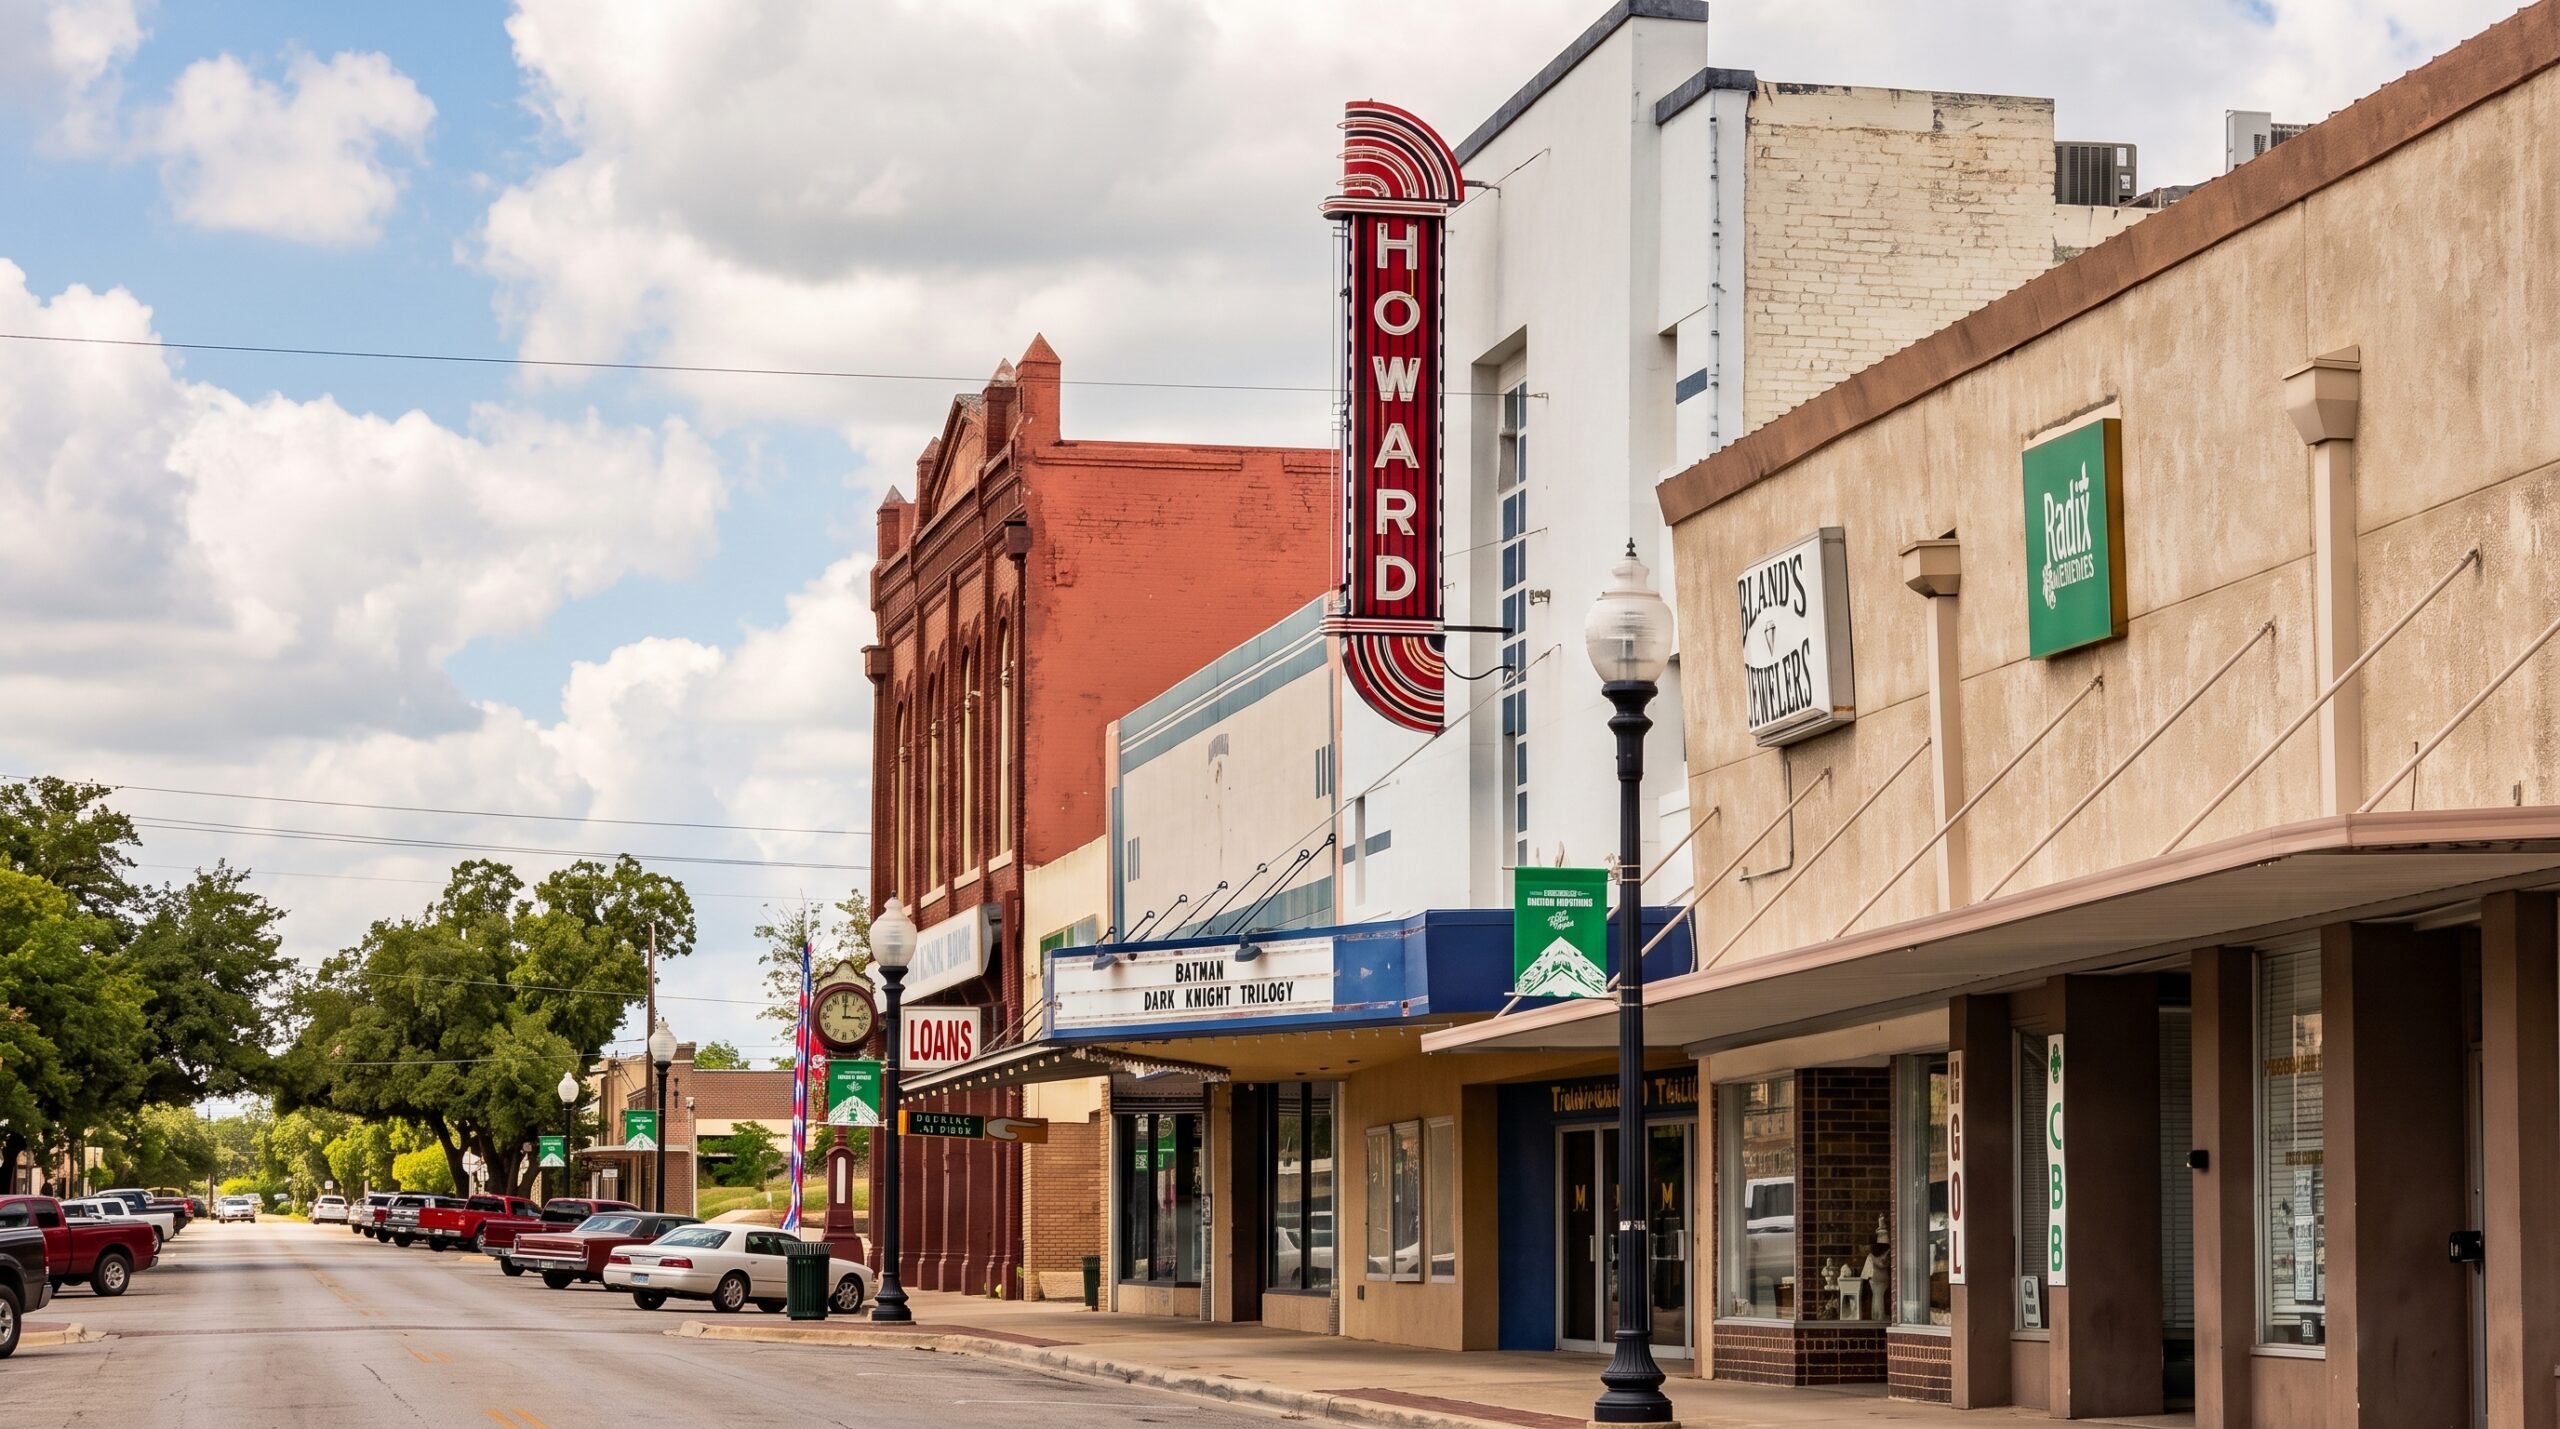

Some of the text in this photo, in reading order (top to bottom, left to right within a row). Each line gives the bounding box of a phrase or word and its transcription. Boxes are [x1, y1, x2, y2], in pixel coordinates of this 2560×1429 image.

[1372, 222, 1421, 601] HOWARD
[2043, 478, 2092, 562] Radix
[1738, 553, 1807, 648] BLAND'S
[1745, 637, 1812, 729] JEWELERS
[1144, 981, 1294, 1011] DARK KNIGHT TRILOGY
[1175, 960, 1224, 983] BATMAN
[909, 1019, 972, 1062] LOANS
